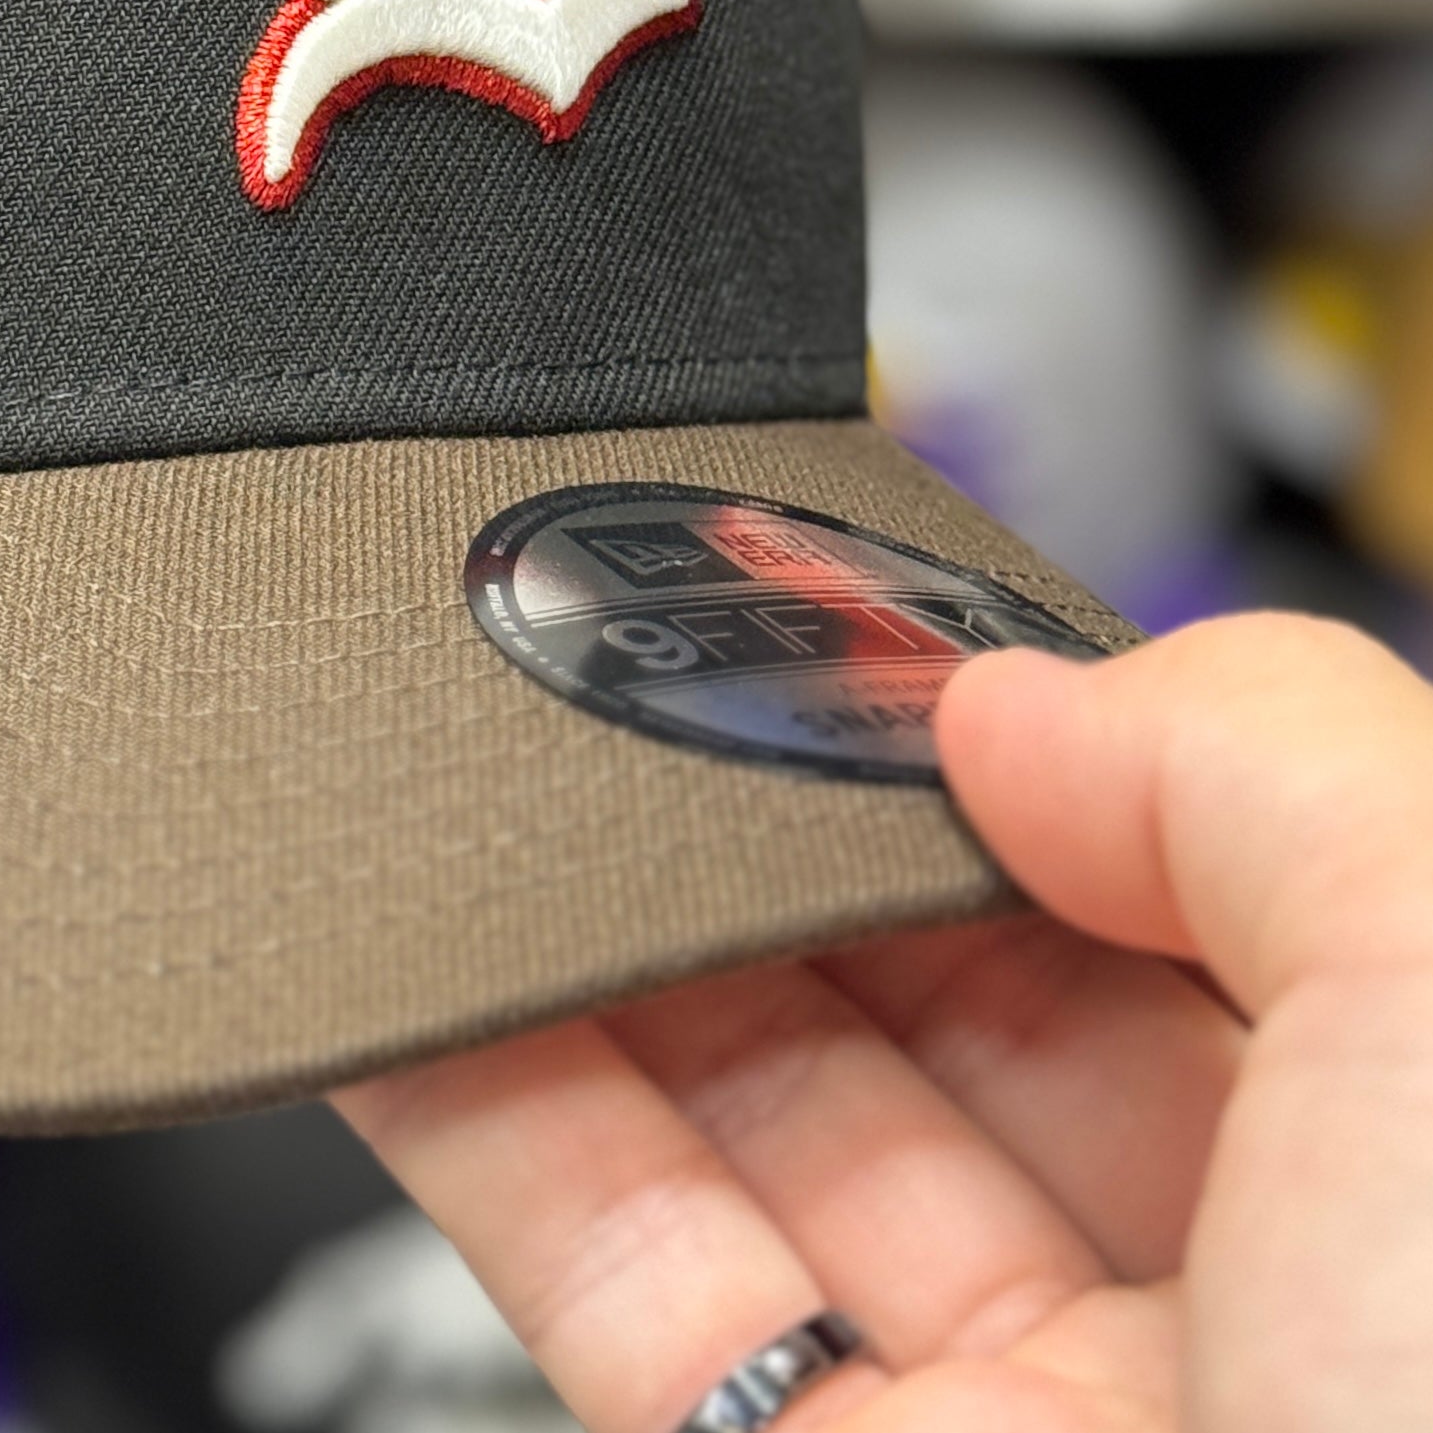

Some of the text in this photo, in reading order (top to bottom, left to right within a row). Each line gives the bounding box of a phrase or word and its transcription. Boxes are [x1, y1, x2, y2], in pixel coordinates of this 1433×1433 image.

[712, 531, 806, 549] NEW
[737, 549, 832, 566] ERA
[602, 602, 998, 670] 9FIFTY
